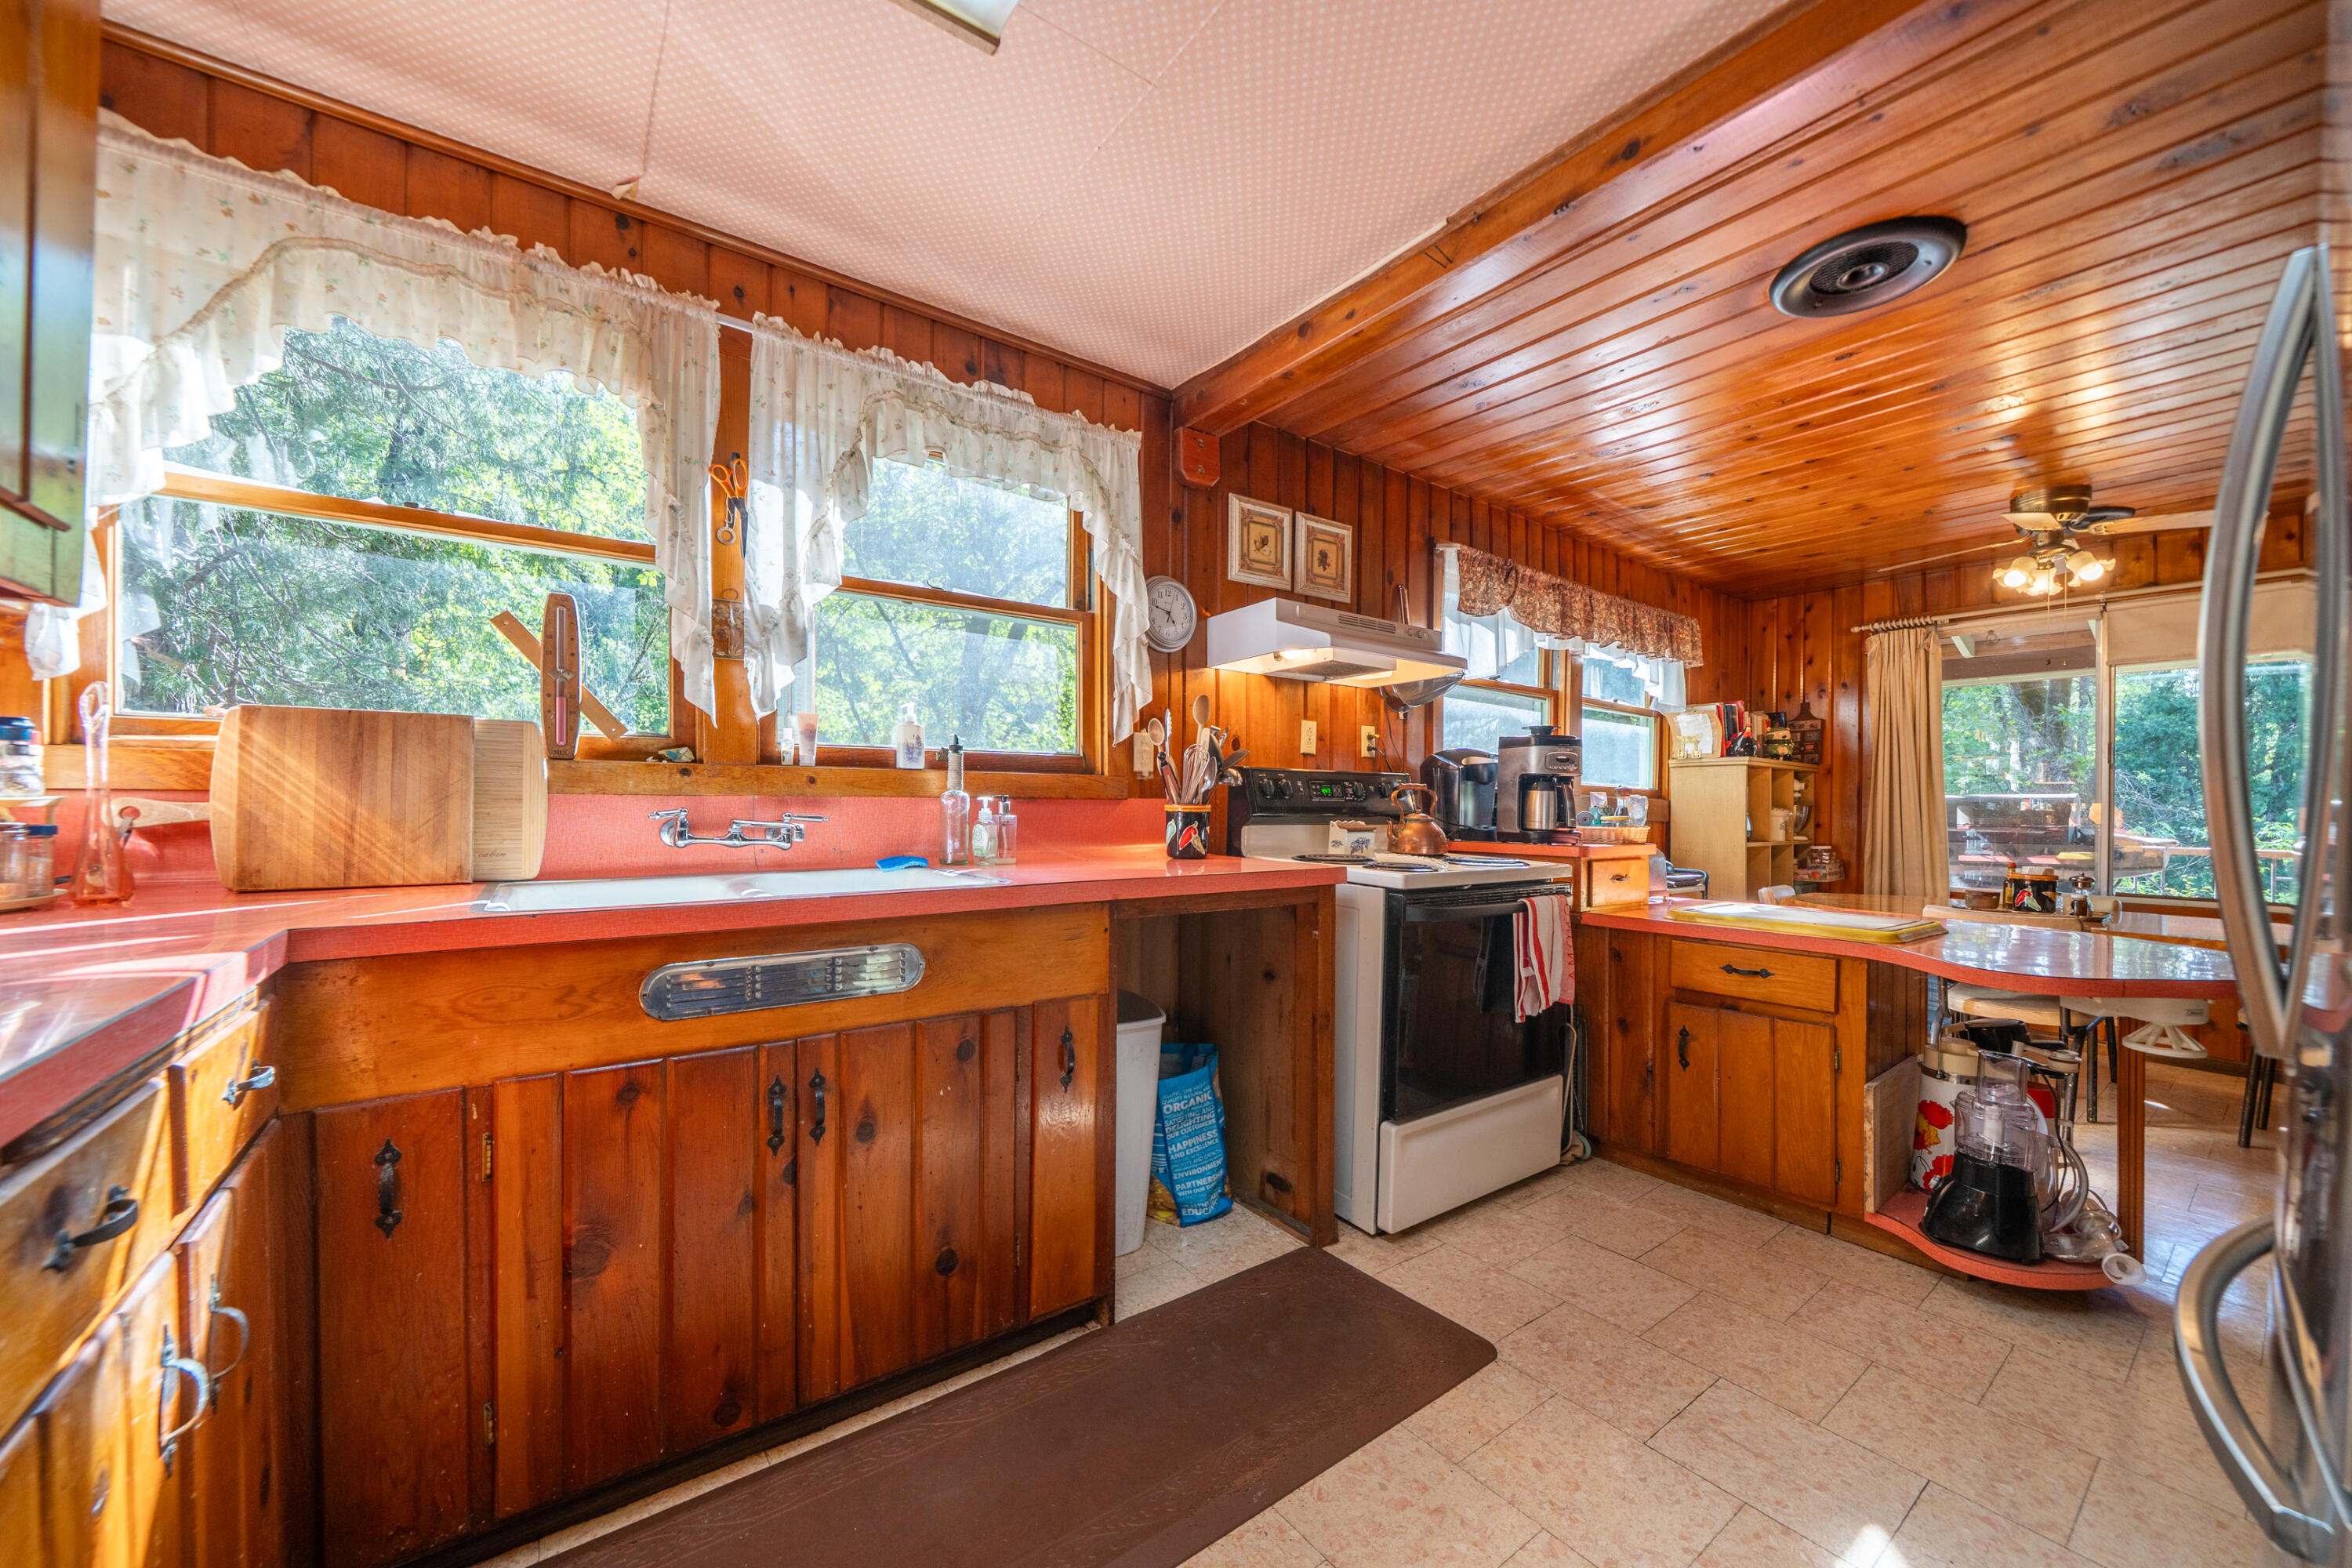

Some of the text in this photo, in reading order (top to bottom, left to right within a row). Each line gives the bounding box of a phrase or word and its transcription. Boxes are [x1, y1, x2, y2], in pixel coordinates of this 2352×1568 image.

[1163, 1090, 1213, 1114] ORGANIC
[1164, 1104, 1214, 1127] SATISFYING AND
[1165, 1110, 1215, 1134] DELIGHTING
[1166, 1131, 1180, 1140] OUR
[1180, 1118, 1216, 1134] CUSTOMERS
[1168, 1129, 1218, 1154] HAPPINESS
[1171, 1151, 1185, 1160] AND
[1185, 1138, 1219, 1156] EXCELLENCE
[1177, 1189, 1192, 1197] WITH
